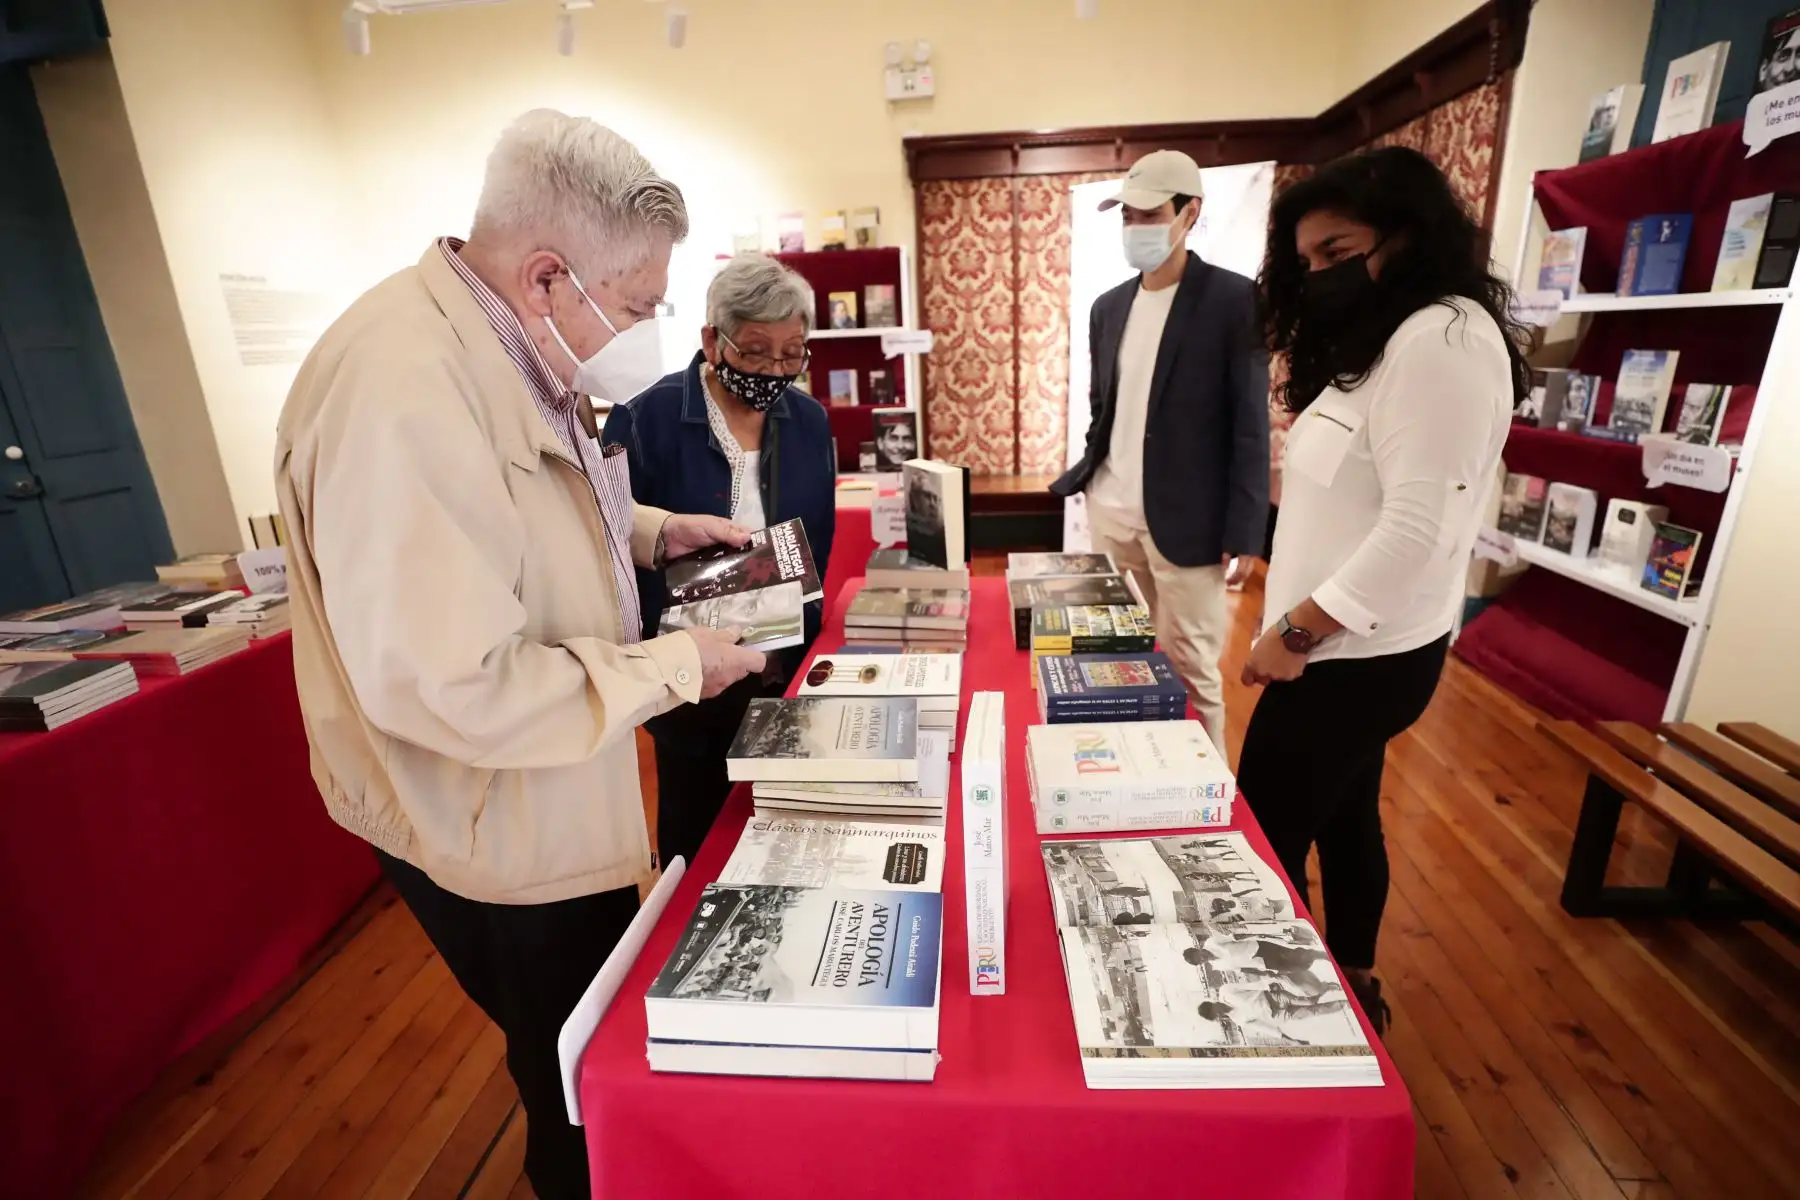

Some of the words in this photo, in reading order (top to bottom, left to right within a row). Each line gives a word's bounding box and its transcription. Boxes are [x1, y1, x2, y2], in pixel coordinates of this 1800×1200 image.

[1766, 115, 1782, 127] los
[781, 522, 806, 576] MARIÁTEGUI
[753, 820, 818, 834] Clásicos
[823, 826, 938, 840] Sanmarquinos
[983, 834, 992, 858] Matos
[838, 901, 848, 916] JOSÉ
[832, 918, 844, 945] CARLOS
[911, 915, 921, 935] Guido
[833, 901, 864, 988] AVENTURERO
[858, 939, 866, 949] DEL
[858, 903, 890, 987] APOLOGÍA
